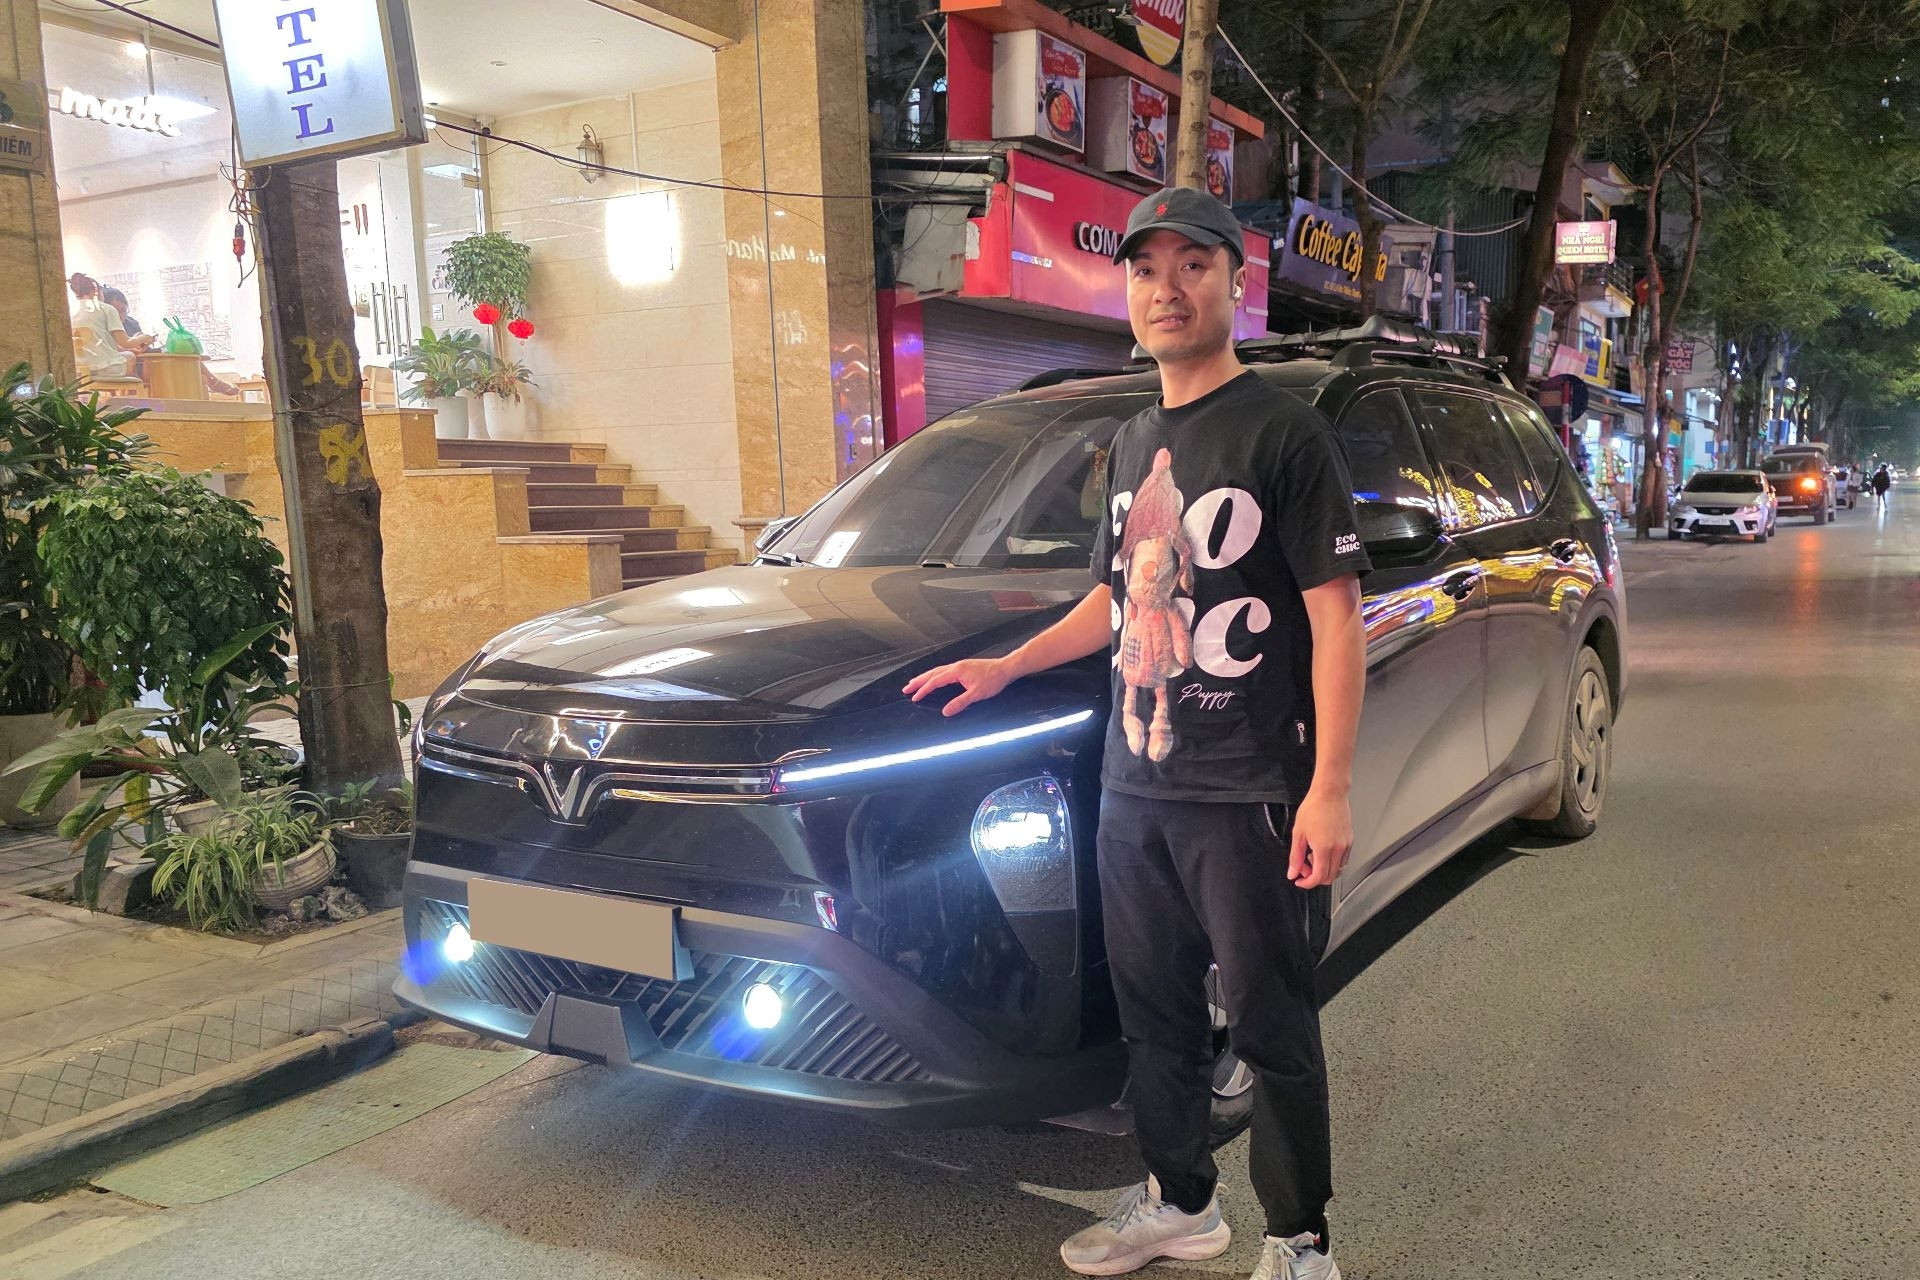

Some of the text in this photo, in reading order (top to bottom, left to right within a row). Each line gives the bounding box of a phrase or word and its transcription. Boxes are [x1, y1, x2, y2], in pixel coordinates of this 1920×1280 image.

[276, 0, 334, 140] TEL
[1079, 221, 1118, 256] CƠM
[1298, 214, 1342, 267] Coffee
[1584, 246, 1609, 254] HOTEL
[291, 337, 354, 388] 30
[1335, 533, 1357, 546] ECO
[1335, 541, 1360, 554] CHIC
[1178, 683, 1236, 710] Puppy
